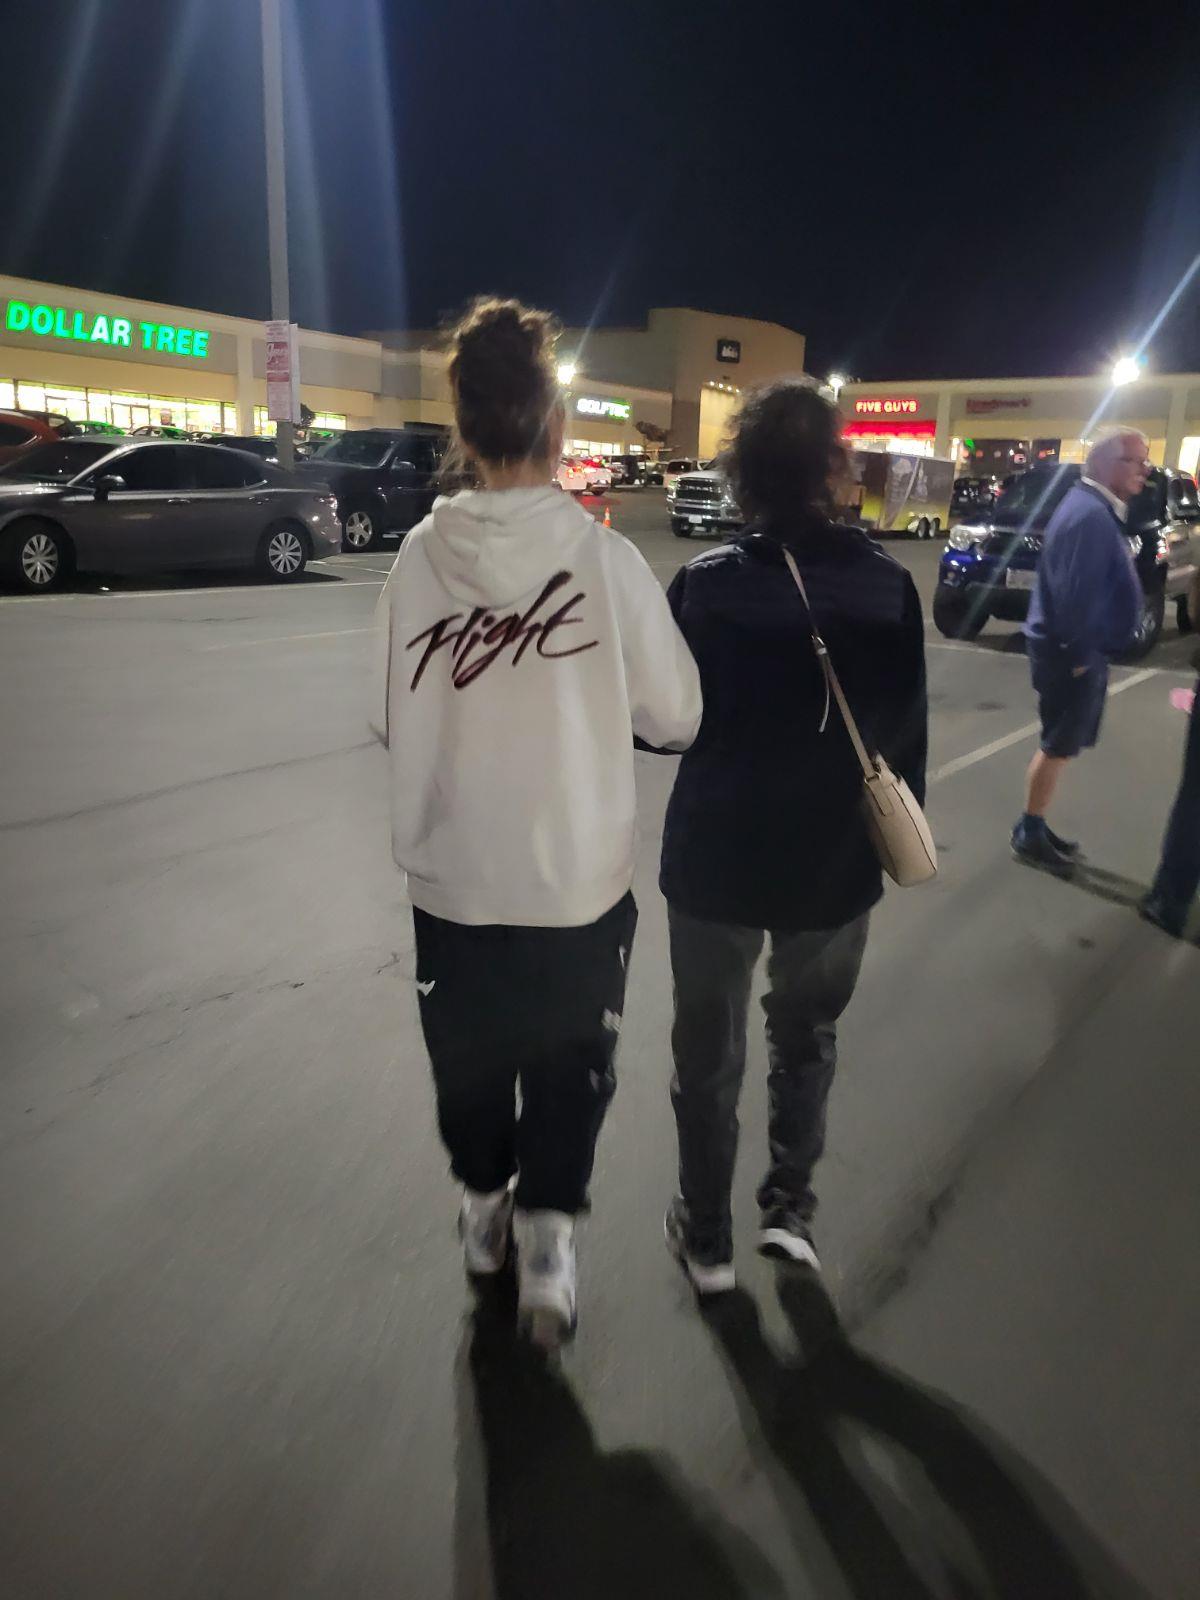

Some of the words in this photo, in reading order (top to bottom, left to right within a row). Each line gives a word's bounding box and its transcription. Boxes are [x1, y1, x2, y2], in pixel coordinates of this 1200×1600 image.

[6, 299, 132, 347] DOLLAR
[139, 321, 210, 357] TREE
[855, 400, 882, 413] FIVE
[883, 400, 918, 413] GUYS
[405, 570, 600, 693] Flight
